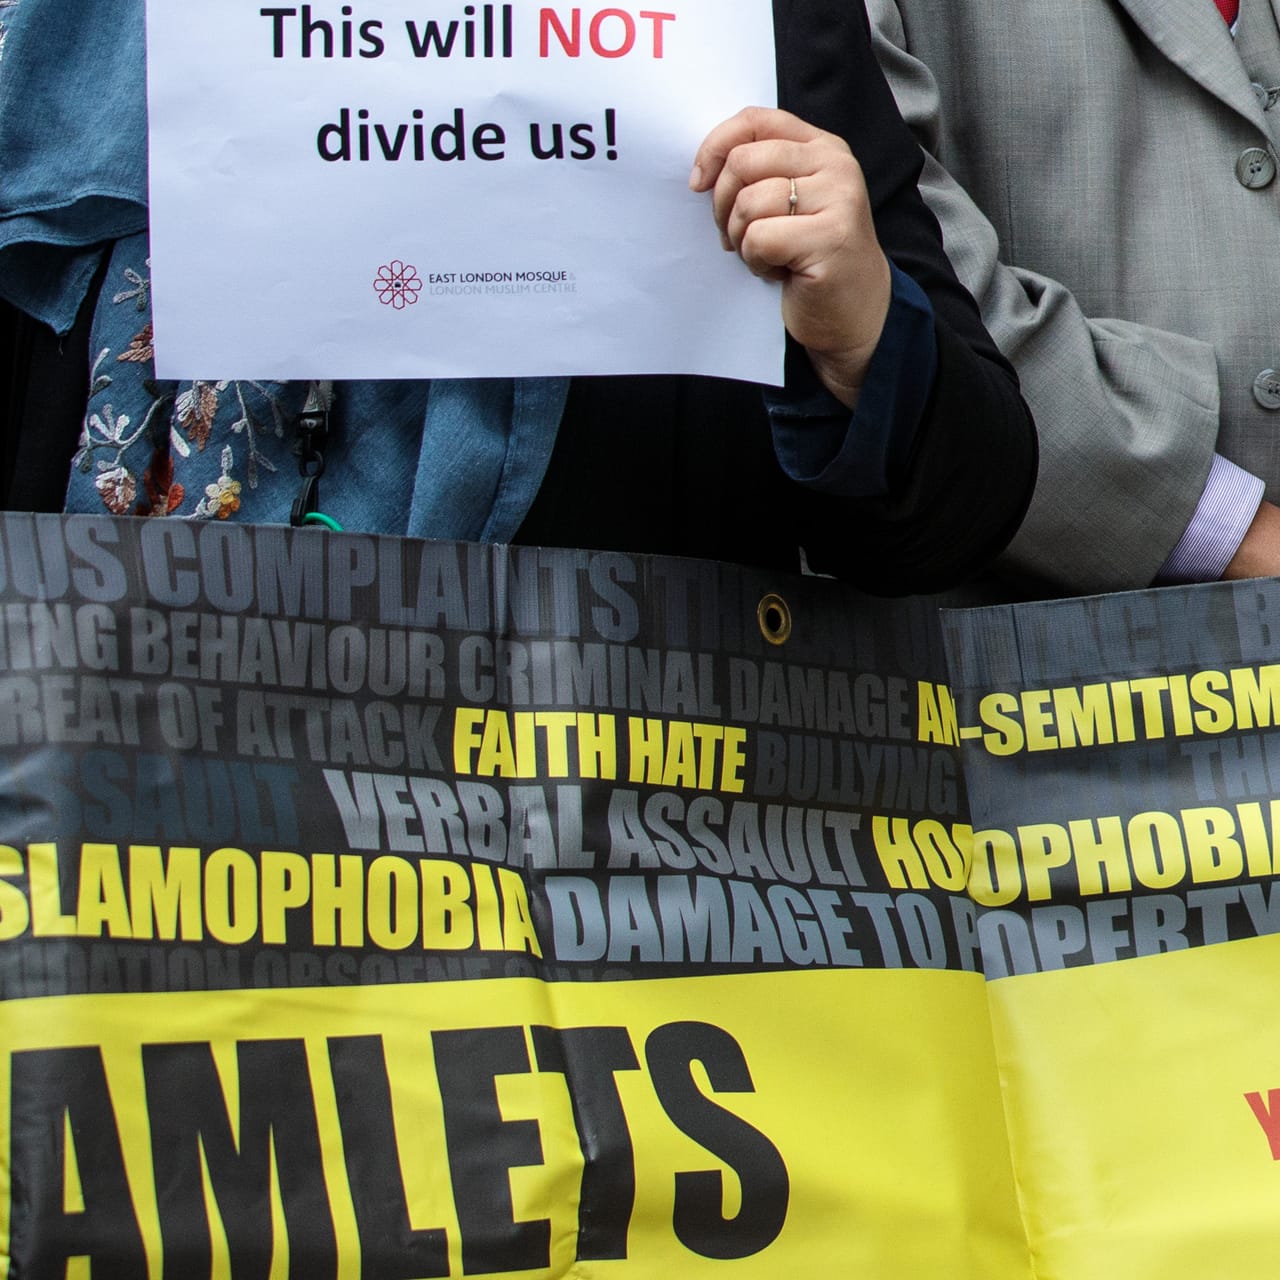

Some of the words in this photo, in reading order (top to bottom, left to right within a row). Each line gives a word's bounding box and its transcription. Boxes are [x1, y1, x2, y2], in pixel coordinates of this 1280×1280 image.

[260, 4, 385, 59] This
[405, 4, 513, 58] will
[539, 7, 676, 59] NOT
[317, 108, 505, 161] divide
[530, 108, 618, 161] us!
[429, 273, 456, 283] EAST
[460, 272, 512, 283] LONDON
[515, 271, 567, 283] MOSQUE
[429, 284, 482, 296] LONDON
[485, 283, 530, 295] MUSLIM
[533, 282, 577, 294] CENTRE
[0, 517, 127, 603] US
[141, 520, 640, 644] COMPLAINTS
[131, 609, 446, 700] BEHAVIOUR
[459, 633, 722, 720] CRIMINAL
[729, 655, 912, 740] DAMAGE
[157, 681, 225, 754] OF
[238, 686, 444, 772] ATTACK
[453, 706, 616, 781] FAITH
[628, 715, 747, 793] HATE
[753, 729, 958, 815] BULLYING
[323, 768, 596, 869] VERBAL
[607, 789, 868, 888] ASSAULT
[545, 874, 864, 964] DAMAGE
[860, 890, 948, 969] TO
[5, 1019, 789, 1280] AMLETS
